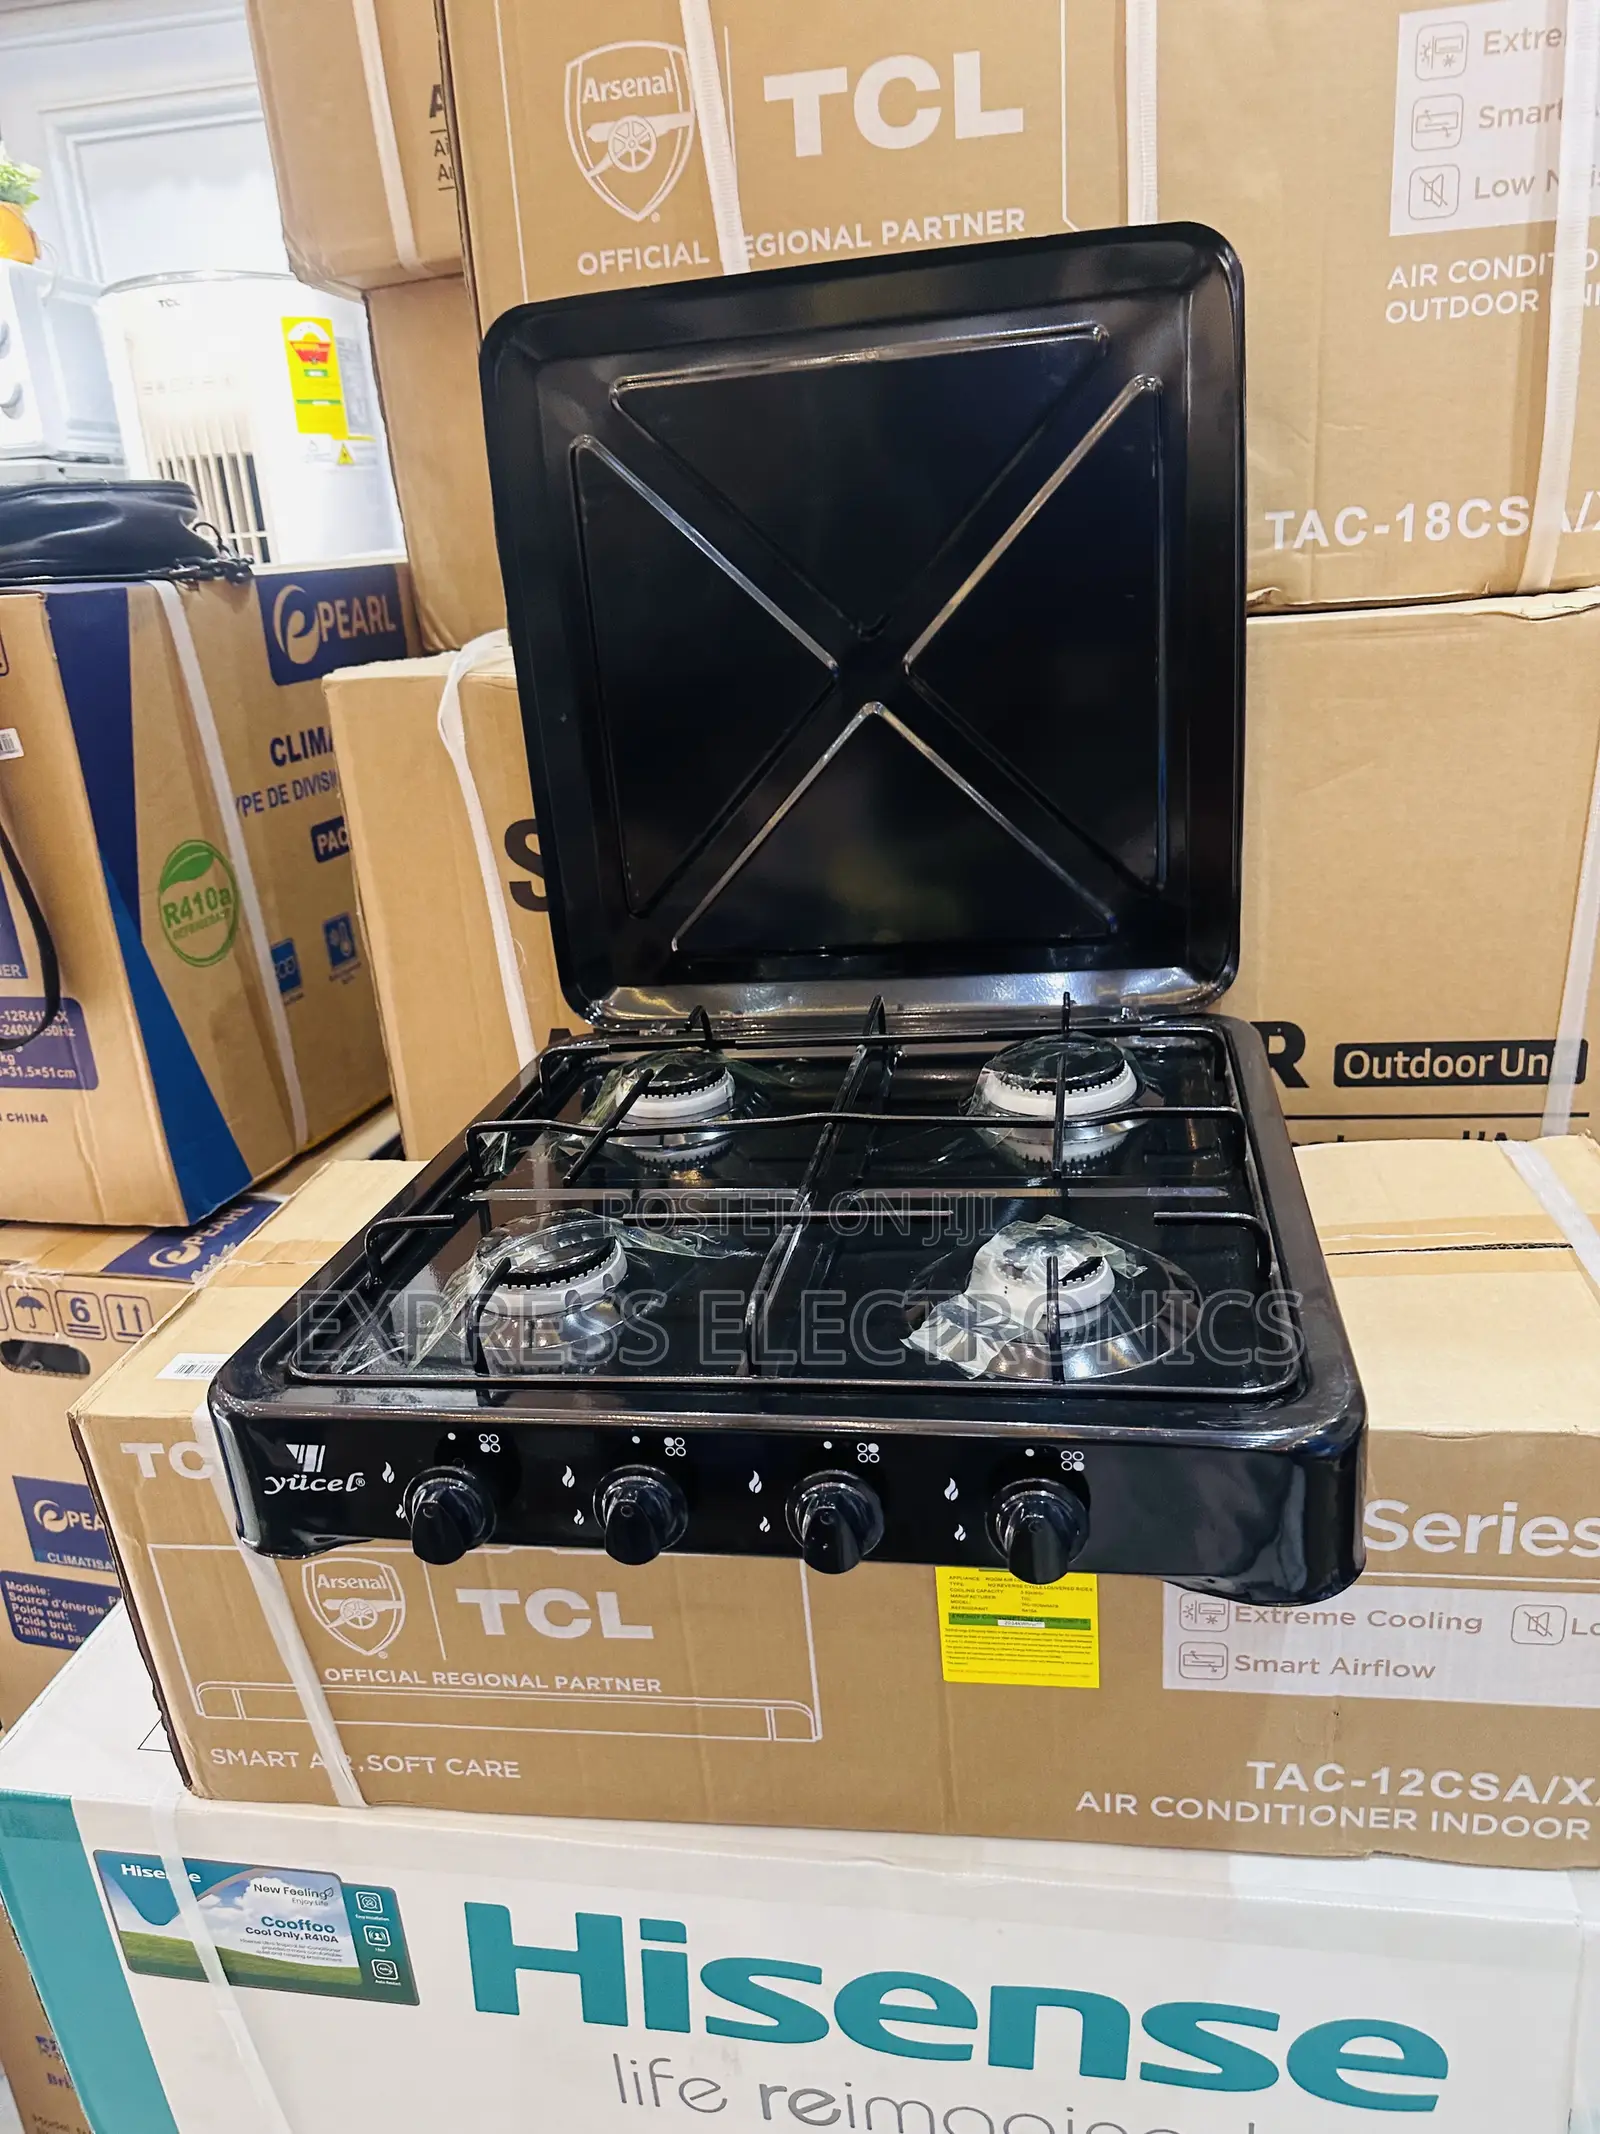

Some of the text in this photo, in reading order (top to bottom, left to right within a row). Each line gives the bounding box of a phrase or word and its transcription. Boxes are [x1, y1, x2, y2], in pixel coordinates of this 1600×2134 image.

[1483, 25, 1567, 55] Extre
[582, 67, 675, 104] Arsenal
[764, 50, 1023, 157] TCL
[1474, 174, 1535, 200] Low
[577, 208, 1025, 276] OFFICIAL EGIONAL PARTNER
[1387, 263, 1438, 290] AIR
[1385, 290, 1539, 324] OUTDOOR
[317, 594, 396, 642] PEARL
[267, 783, 290, 809] DE
[163, 887, 231, 928] R410a
[1343, 1048, 1494, 1079] Outdoor
[1500, 1049, 1560, 1079] Un
[7, 1112, 48, 1124] CHINA
[120, 1441, 216, 1480] TC
[5, 1580, 51, 1596] Modèle:
[316, 1573, 388, 1591] Arsenal
[8, 1591, 49, 1607] Source
[12, 1603, 70, 1620] Poids net:
[14, 1615, 77, 1632] Poids brut:
[456, 1588, 654, 1639] TCL
[1234, 1606, 1484, 1634] Extreme Cooling
[17, 1624, 48, 1638] Taille
[50, 1631, 66, 1642] du
[324, 1668, 662, 1693] OFFICIAL REGIONAL PARTNER
[1234, 1655, 1437, 1679] Smart Airflow
[210, 1748, 299, 1768] SMART
[445, 1758, 521, 1779] CARE
[1246, 1761, 1600, 1807] TAC-12CSA/X
[1076, 1790, 1590, 1841] AIR CONDITIONER INDOOR
[120, 1863, 202, 1883] Hisee
[254, 1883, 327, 1900] New Feeling
[246, 1926, 272, 1936] Cool
[305, 1933, 339, 1943] R410A
[261, 1916, 335, 1933] Cooffoo
[464, 1901, 1449, 2113] Hisense
[612, 2053, 729, 2114] life
